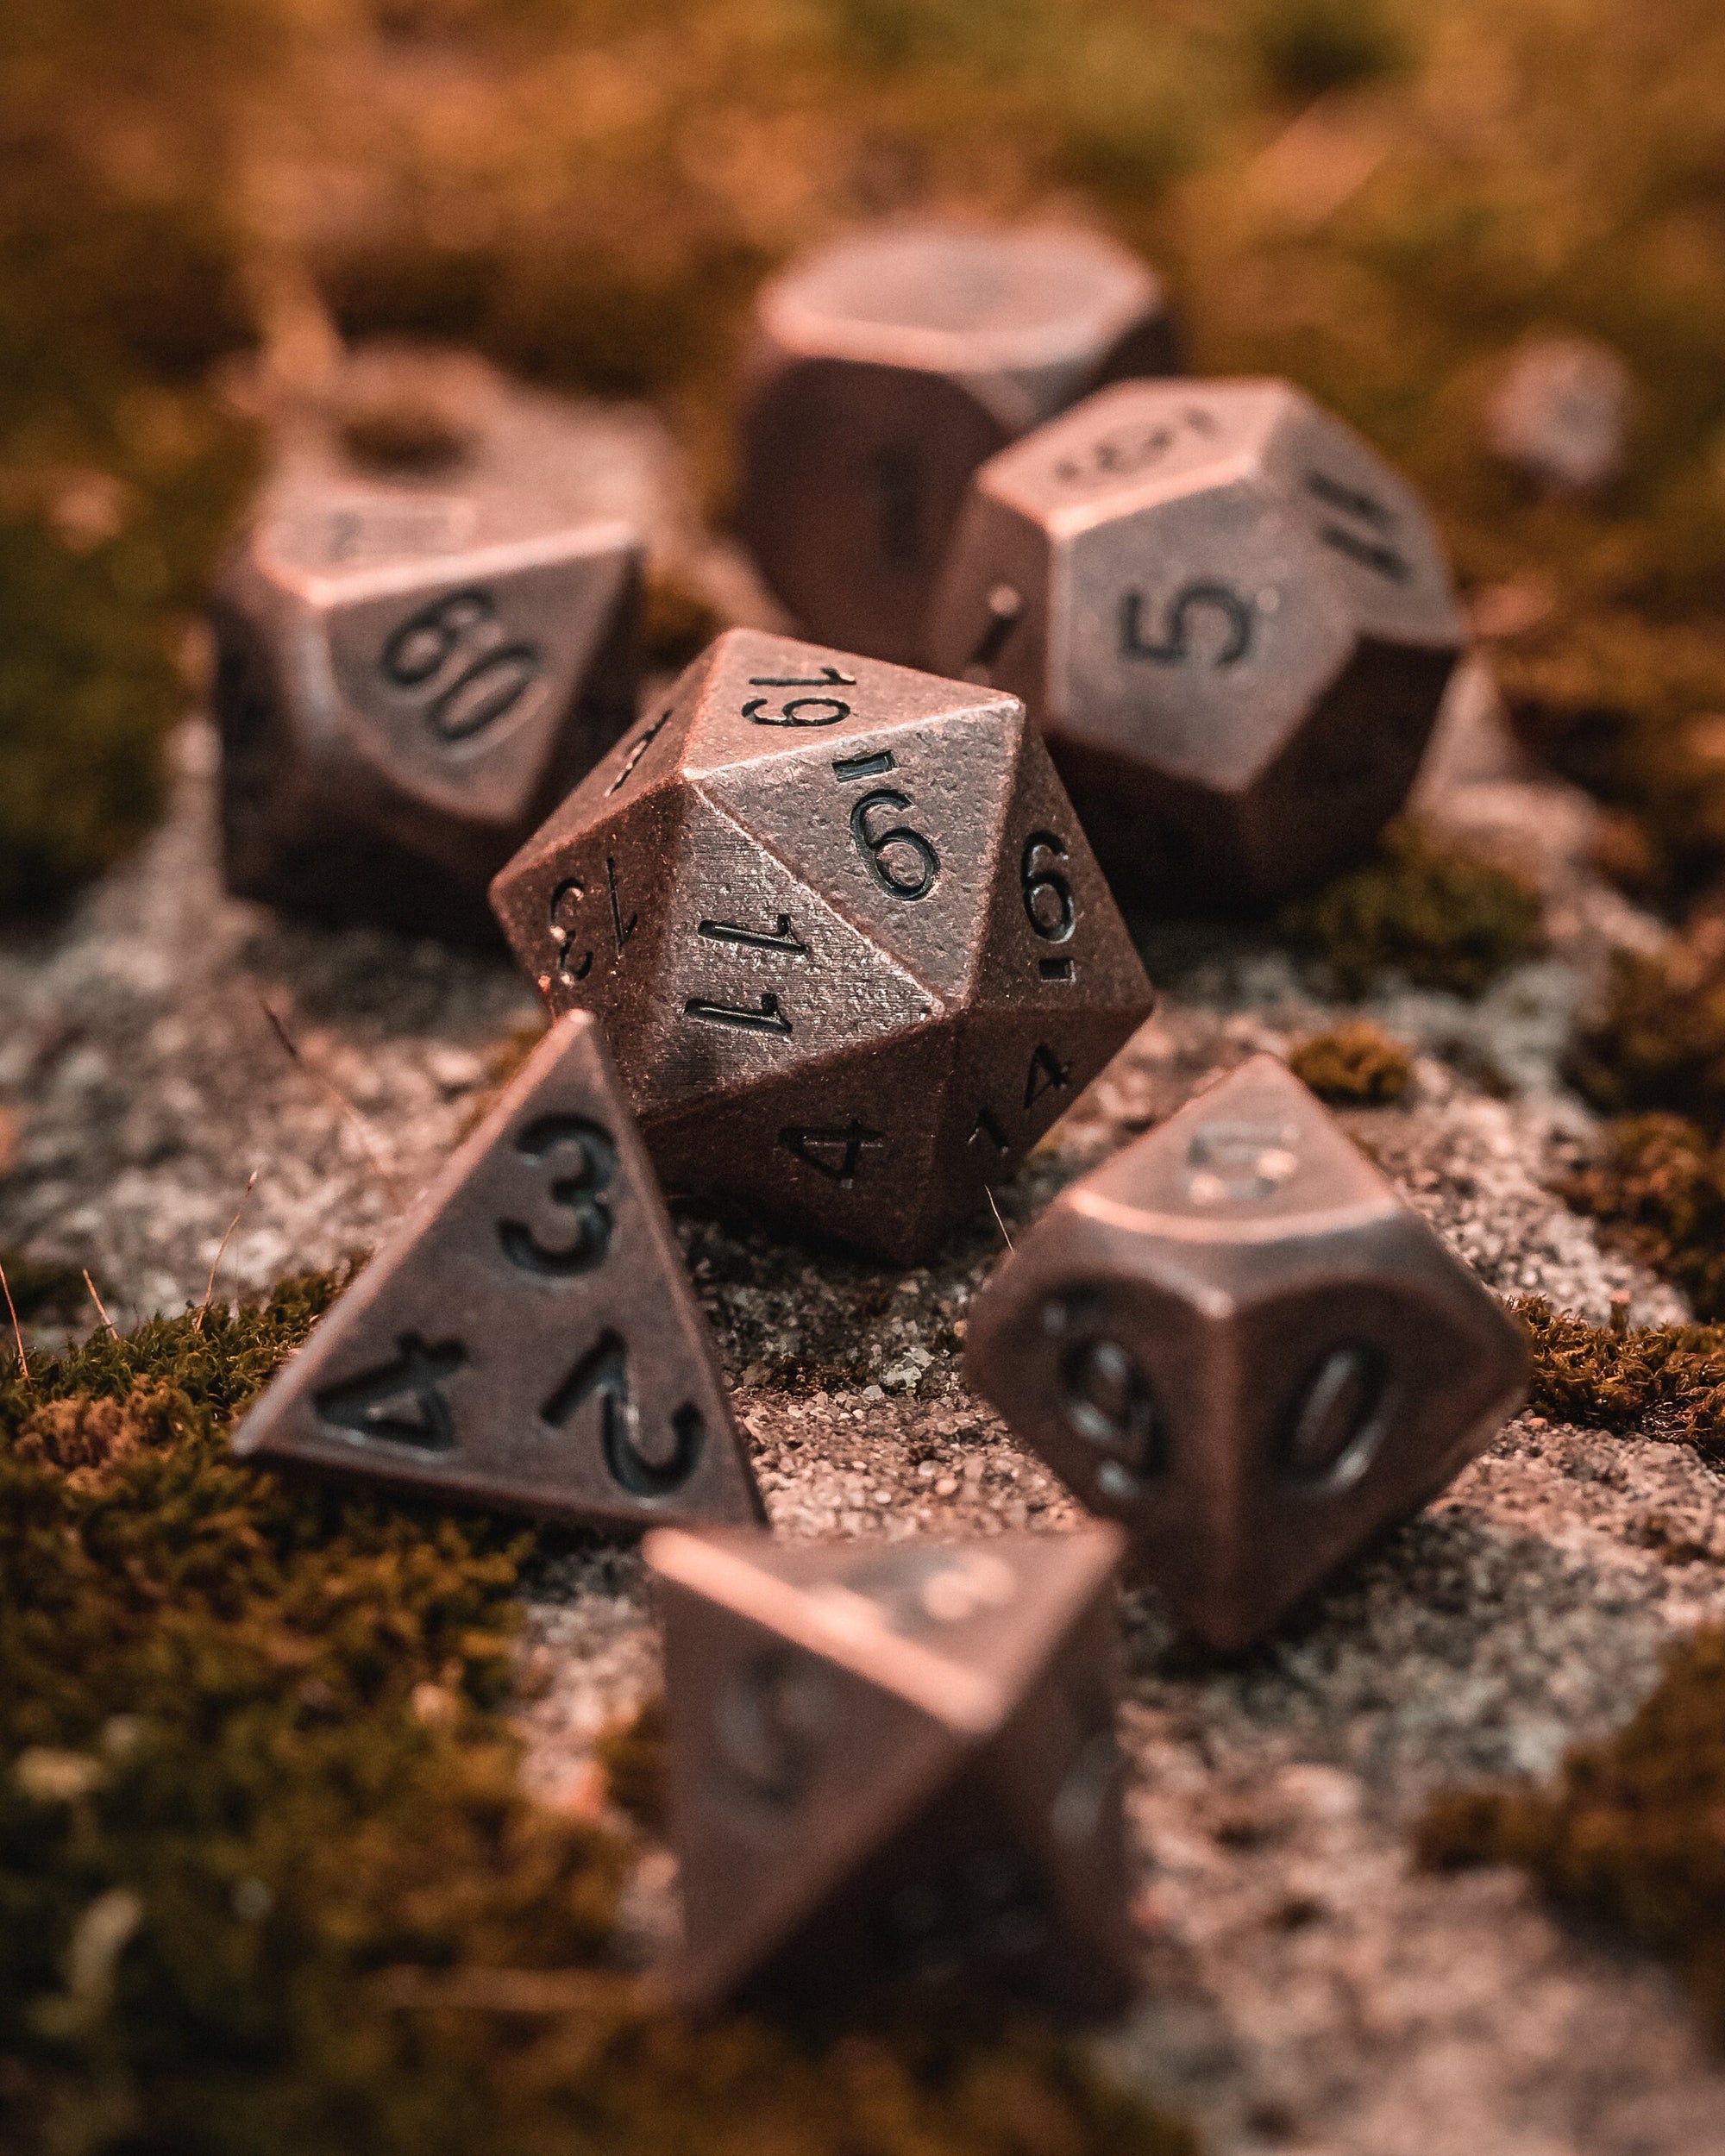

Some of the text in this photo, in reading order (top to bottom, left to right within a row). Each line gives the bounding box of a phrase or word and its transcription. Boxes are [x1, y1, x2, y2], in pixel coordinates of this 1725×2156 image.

[1118, 578, 1252, 667] 5
[742, 667, 857, 728] 19
[683, 912, 809, 1037] 11
[497, 1112, 618, 1280] 3
[779, 1119, 887, 1188] 4
[312, 1328, 473, 1457] 4
[540, 1326, 706, 1499] 2
